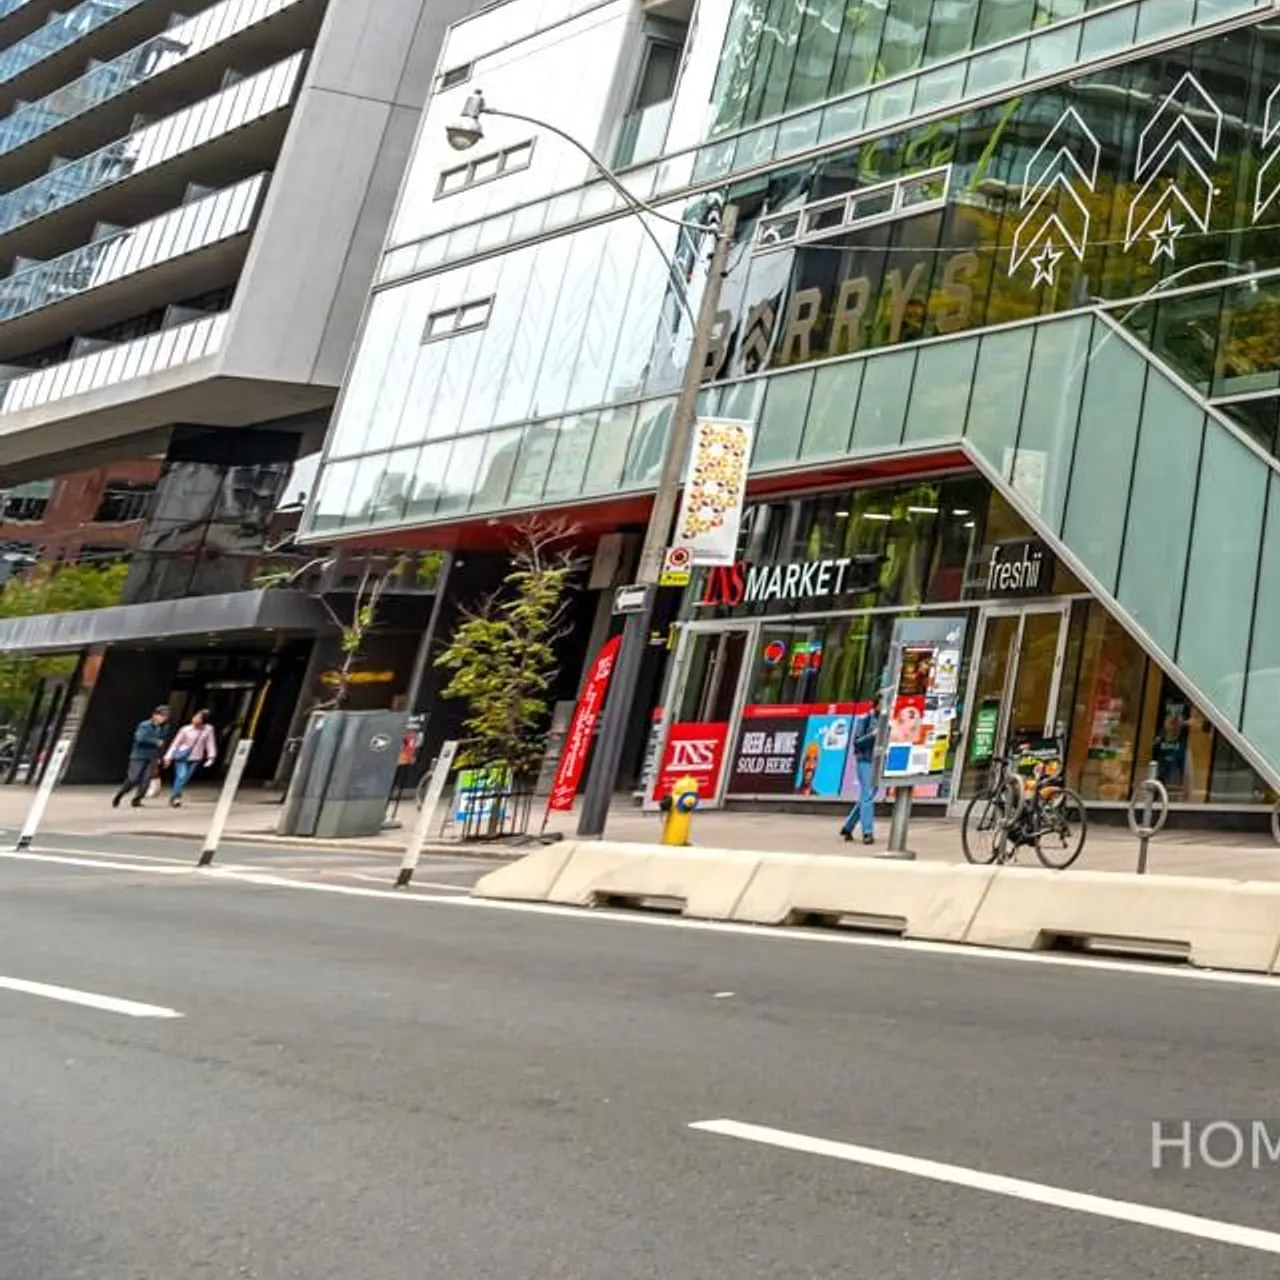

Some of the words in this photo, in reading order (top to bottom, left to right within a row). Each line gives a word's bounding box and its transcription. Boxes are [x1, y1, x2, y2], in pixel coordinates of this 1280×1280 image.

[744, 557, 851, 603] MARKET
[987, 544, 1043, 591] freshii
[667, 739, 719, 771] INS
[737, 757, 764, 773] SOLD
[764, 757, 794, 773] HERE
